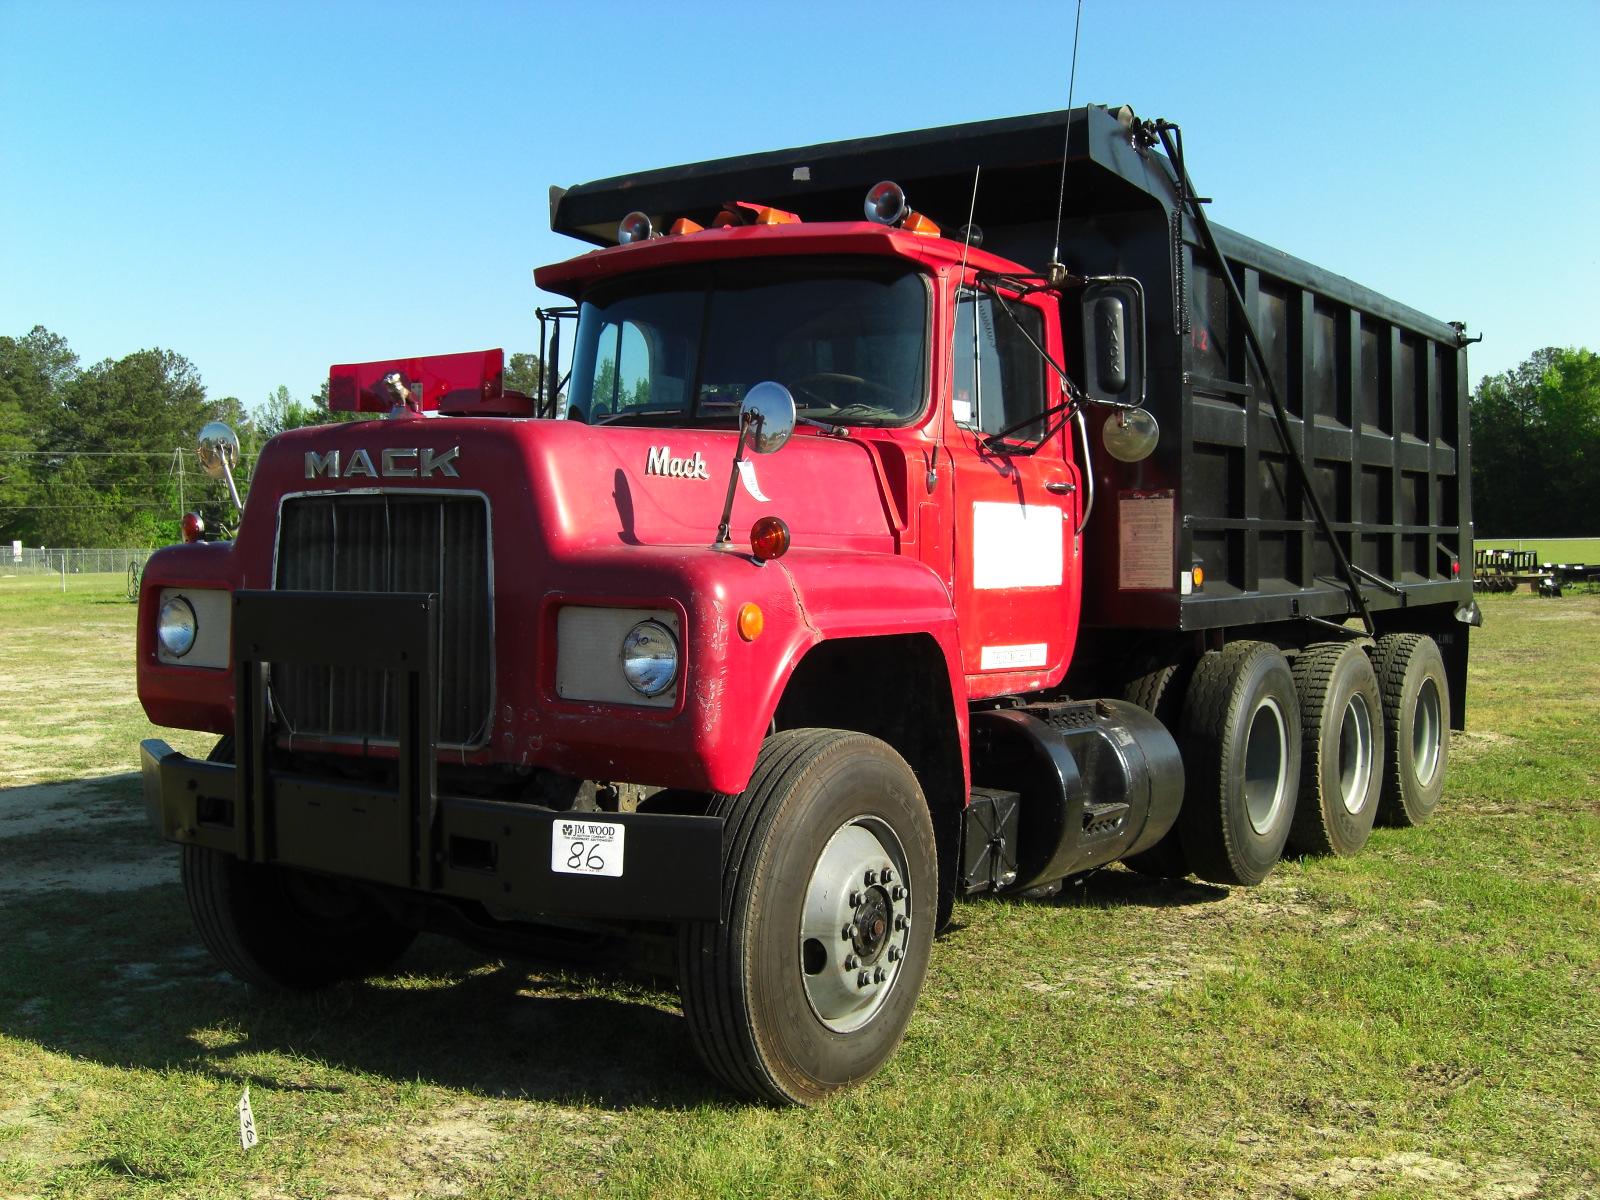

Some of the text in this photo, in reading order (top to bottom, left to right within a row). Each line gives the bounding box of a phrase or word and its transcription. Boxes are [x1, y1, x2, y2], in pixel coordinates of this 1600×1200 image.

[304, 446, 460, 479] MACK
[645, 445, 710, 480] Mack
[573, 824, 615, 836] JM WOOD
[567, 842, 604, 869] 86
